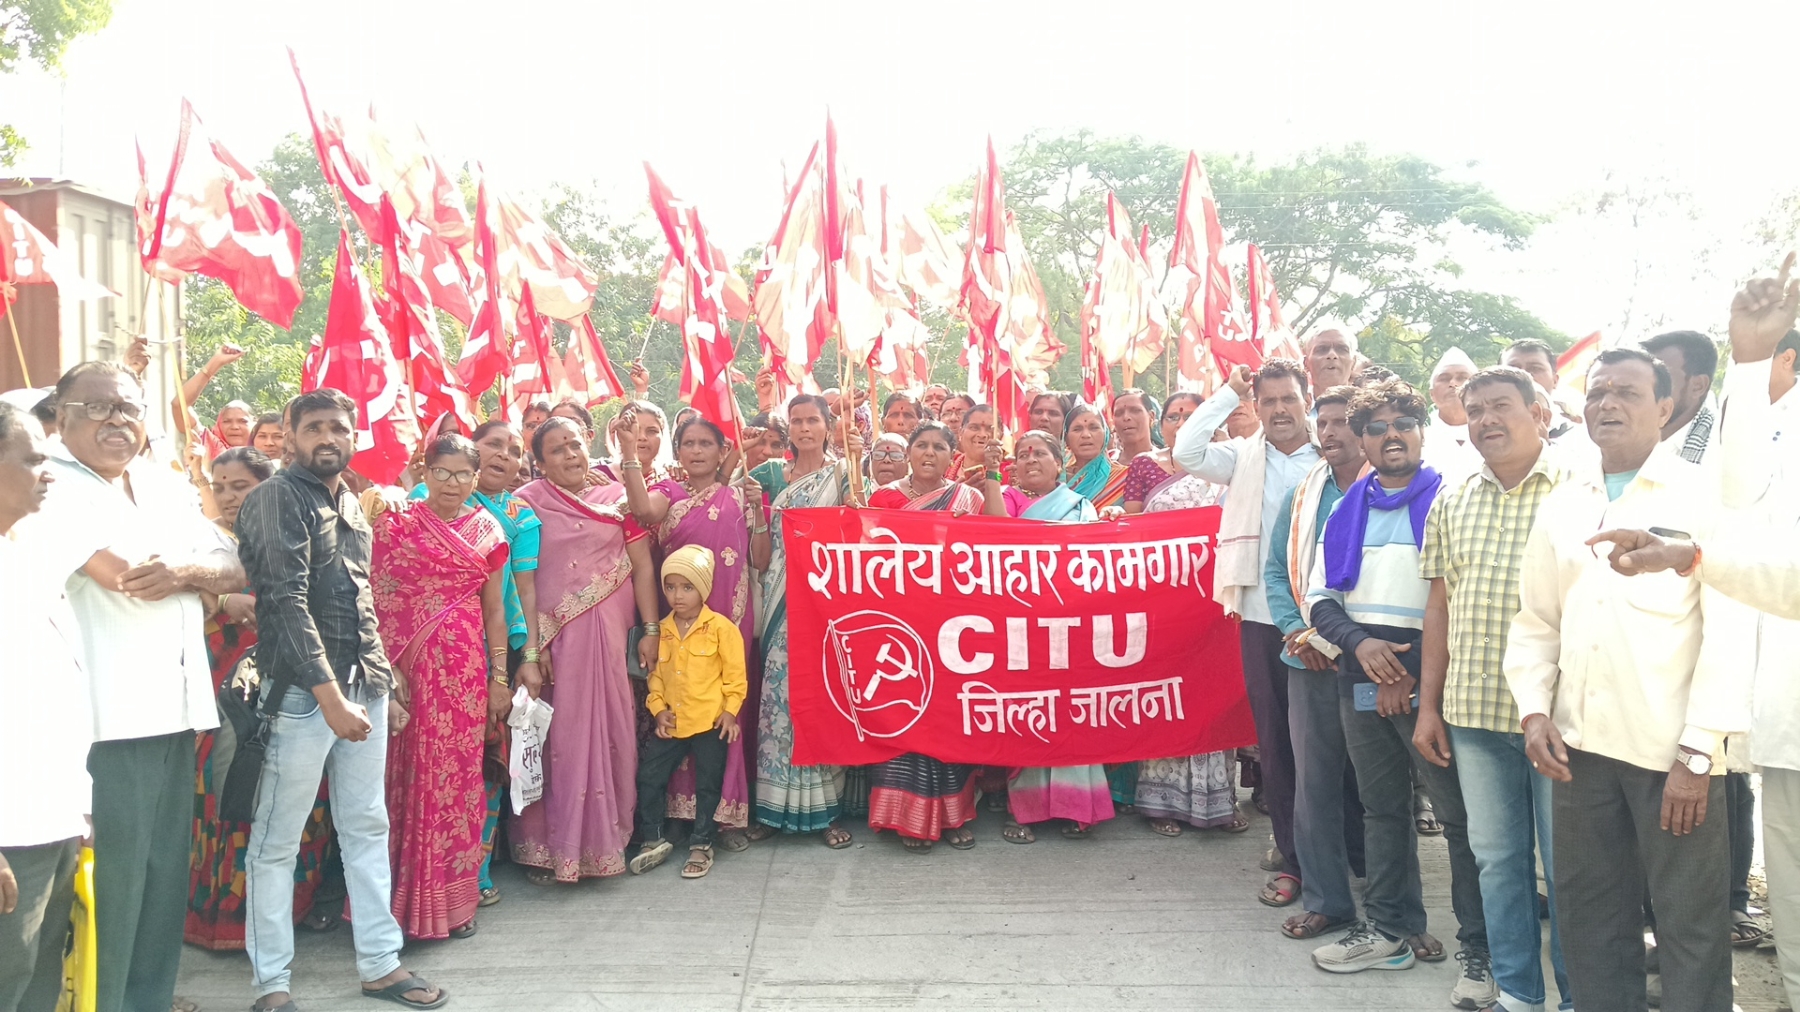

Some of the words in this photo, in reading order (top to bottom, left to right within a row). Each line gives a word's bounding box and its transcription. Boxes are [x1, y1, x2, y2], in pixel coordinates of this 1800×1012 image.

[808, 528, 943, 599] शालेय
[949, 541, 1063, 607] आहार
[1067, 534, 1209, 598] कामगार
[841, 634, 862, 704] CITU
[937, 612, 1147, 675] CITU
[956, 681, 1060, 743] जिल्हा
[1070, 676, 1184, 729] जालना
